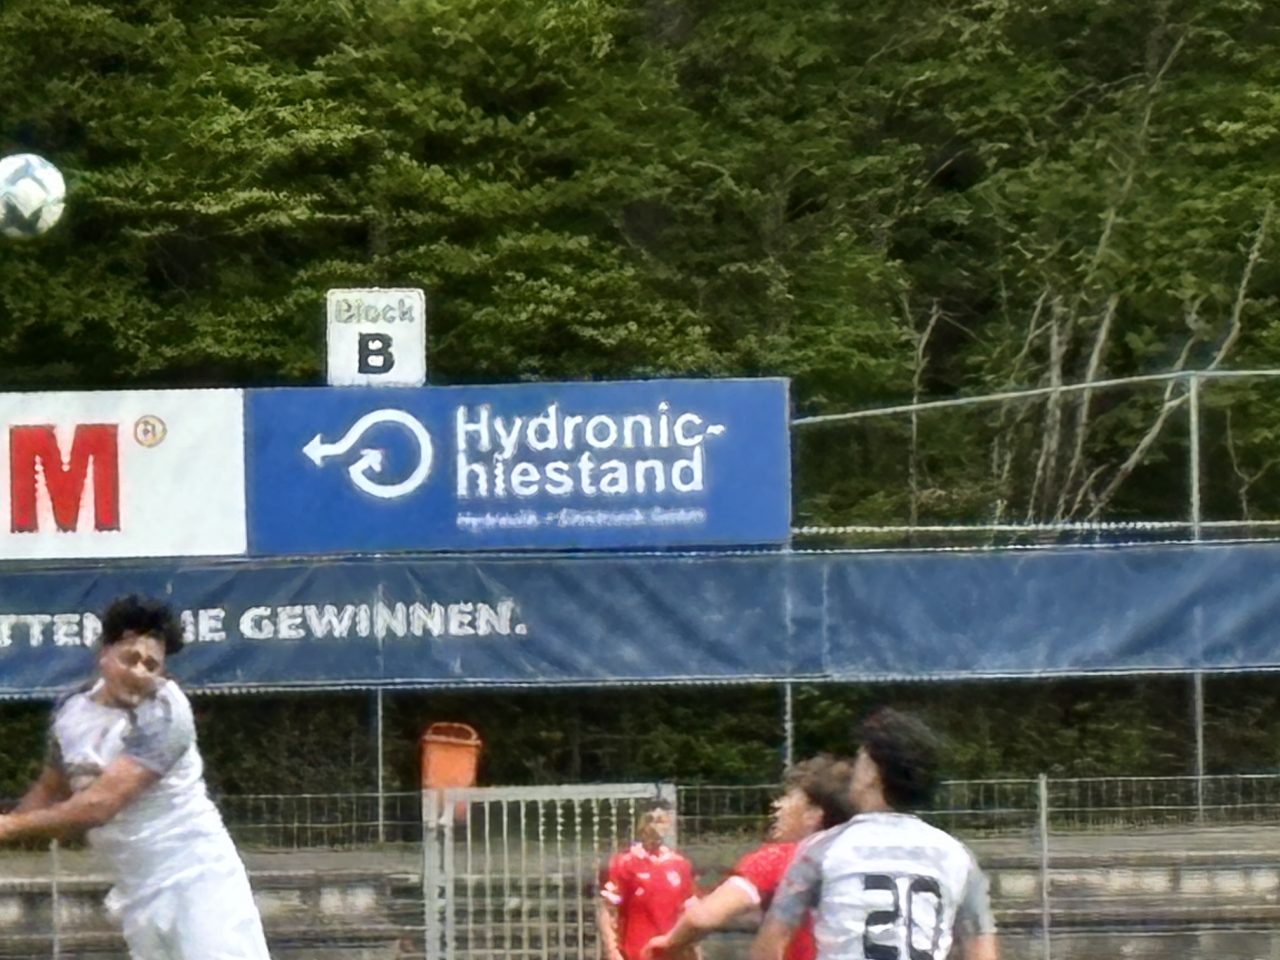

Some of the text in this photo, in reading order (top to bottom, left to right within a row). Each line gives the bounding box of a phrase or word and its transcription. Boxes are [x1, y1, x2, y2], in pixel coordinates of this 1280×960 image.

[358, 332, 395, 374] B
[179, 607, 227, 643] IE
[239, 597, 528, 641] GEWINNEN.
